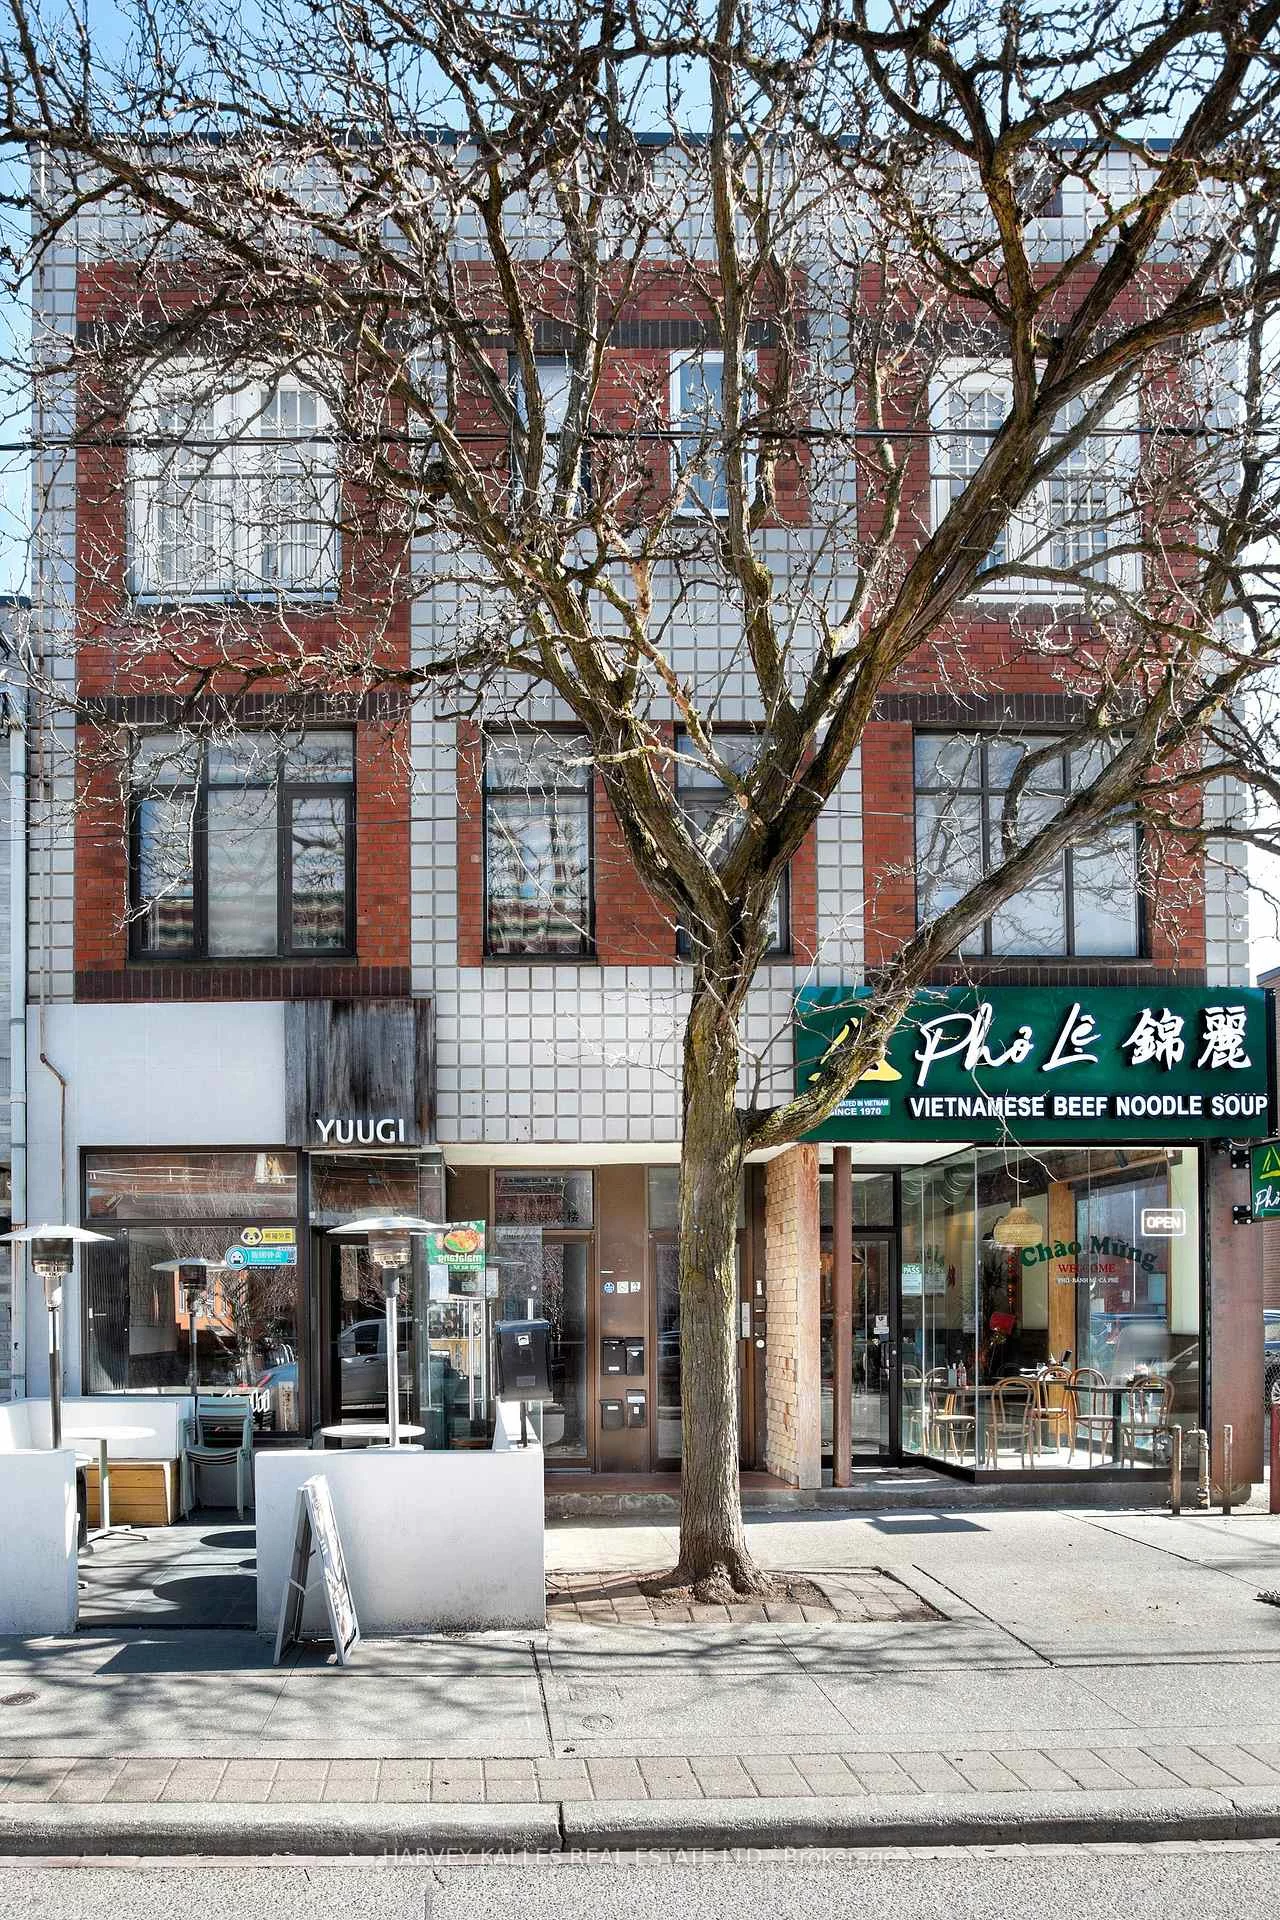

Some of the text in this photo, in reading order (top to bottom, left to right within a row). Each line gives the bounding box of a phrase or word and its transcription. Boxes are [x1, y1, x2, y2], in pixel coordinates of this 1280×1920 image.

[1121, 1005, 1252, 1071] 錦麗
[859, 1107, 882, 1116] 1970
[864, 1099, 889, 1107] VIETNAM
[909, 1095, 1268, 1117] VIETNAMESE BEEF NOODLE SOUP
[315, 1118, 405, 1144] YUUGI
[1145, 1216, 1181, 1229] OPEN
[1020, 1240, 1081, 1267] Chào
[1058, 1263, 1116, 1273] WELCOME
